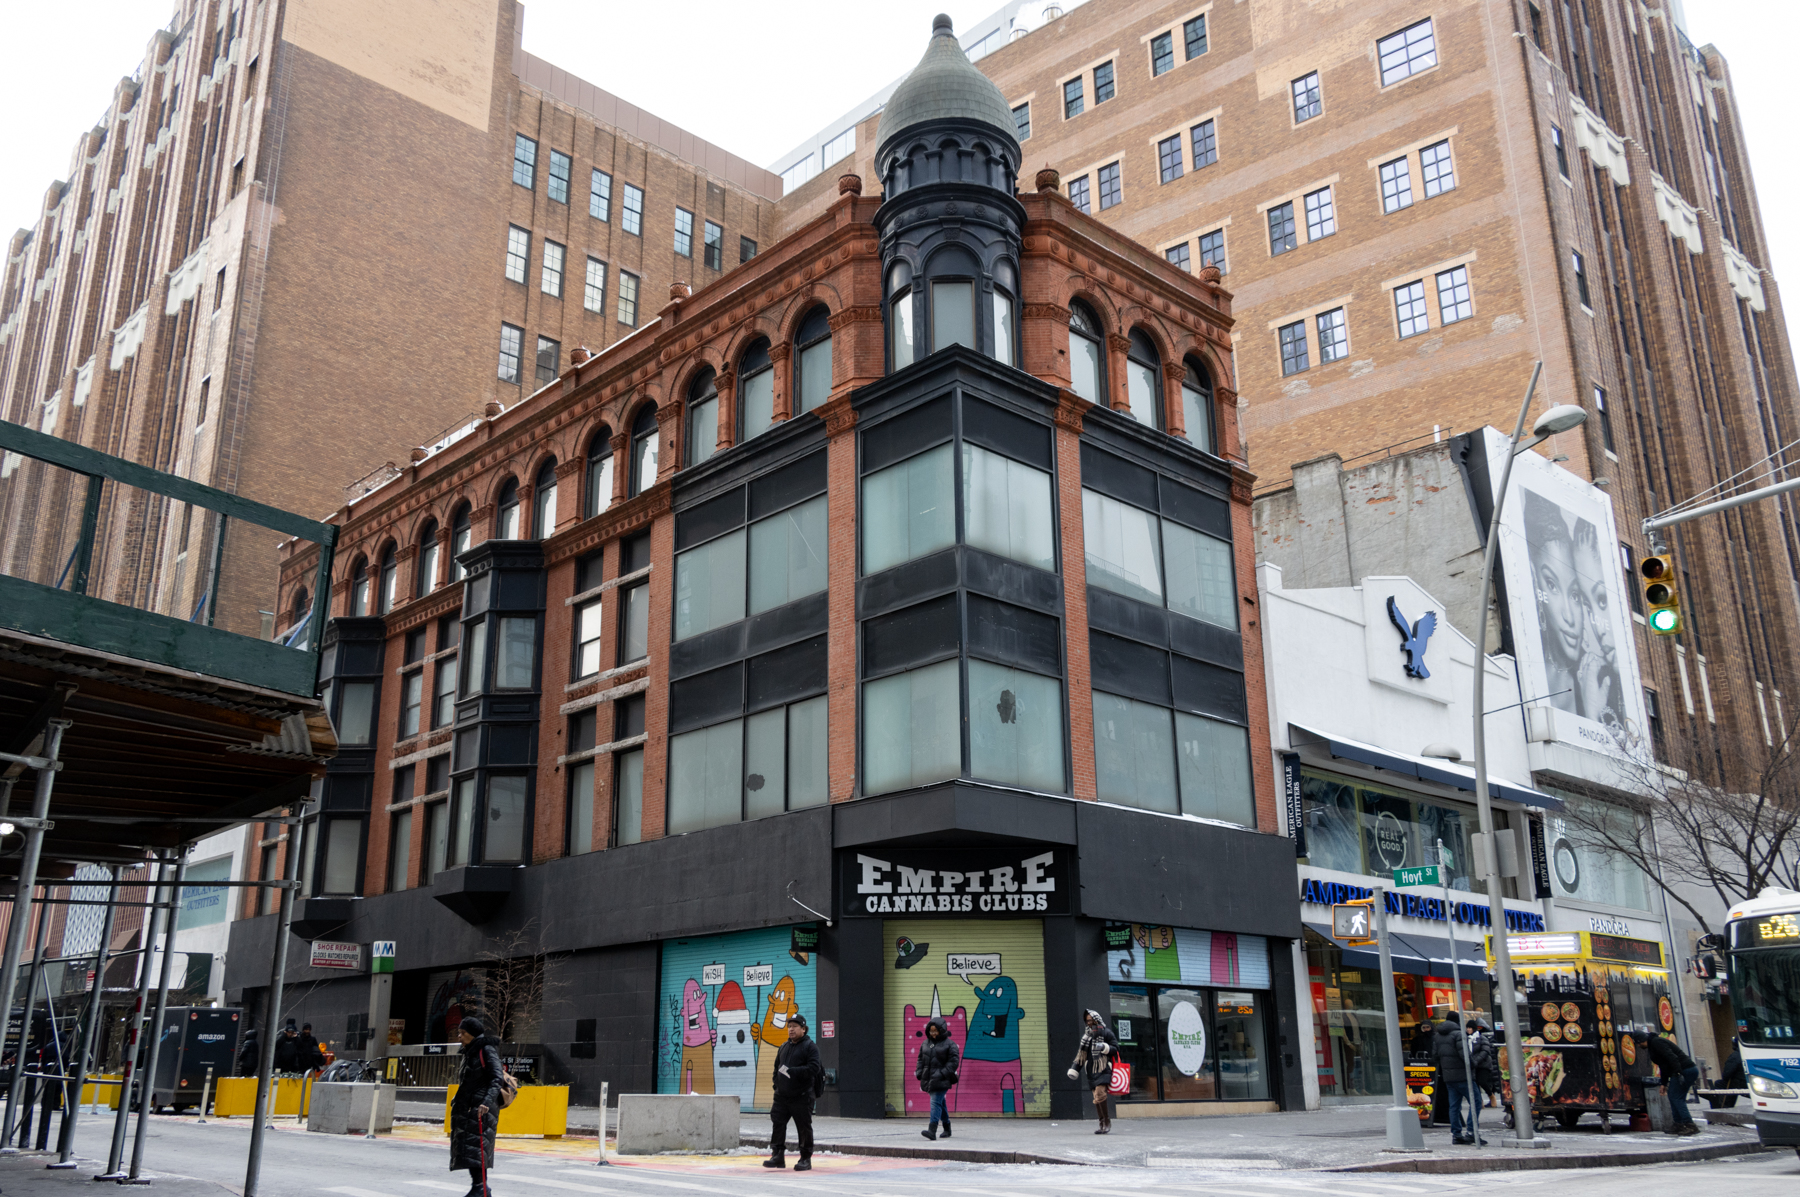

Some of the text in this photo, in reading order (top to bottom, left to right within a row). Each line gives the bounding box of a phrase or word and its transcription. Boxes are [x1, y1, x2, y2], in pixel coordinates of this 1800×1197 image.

[1537, 589, 1549, 604] BE
[1285, 765, 1297, 845] MERICAN EAGLE
[1293, 781, 1302, 828] OUTFITTERS
[1381, 830, 1399, 842] REAL
[857, 851, 1055, 893] EMPIRE
[1402, 868, 1432, 885] Hoyt St
[1540, 863, 1549, 888] EAGLE
[865, 893, 1048, 913] CANNABIS CLUBS
[1460, 902, 1545, 932] OUTTTERS
[1105, 928, 1130, 937] EMPIRE
[1589, 916, 1630, 937] PANDORA
[1759, 914, 1799, 939] B26
[951, 957, 996, 970] Believe
[746, 969, 770, 981] Believe
[1172, 1029, 1202, 1040] EMPIRE
[1779, 1058, 1799, 1066] 7192
